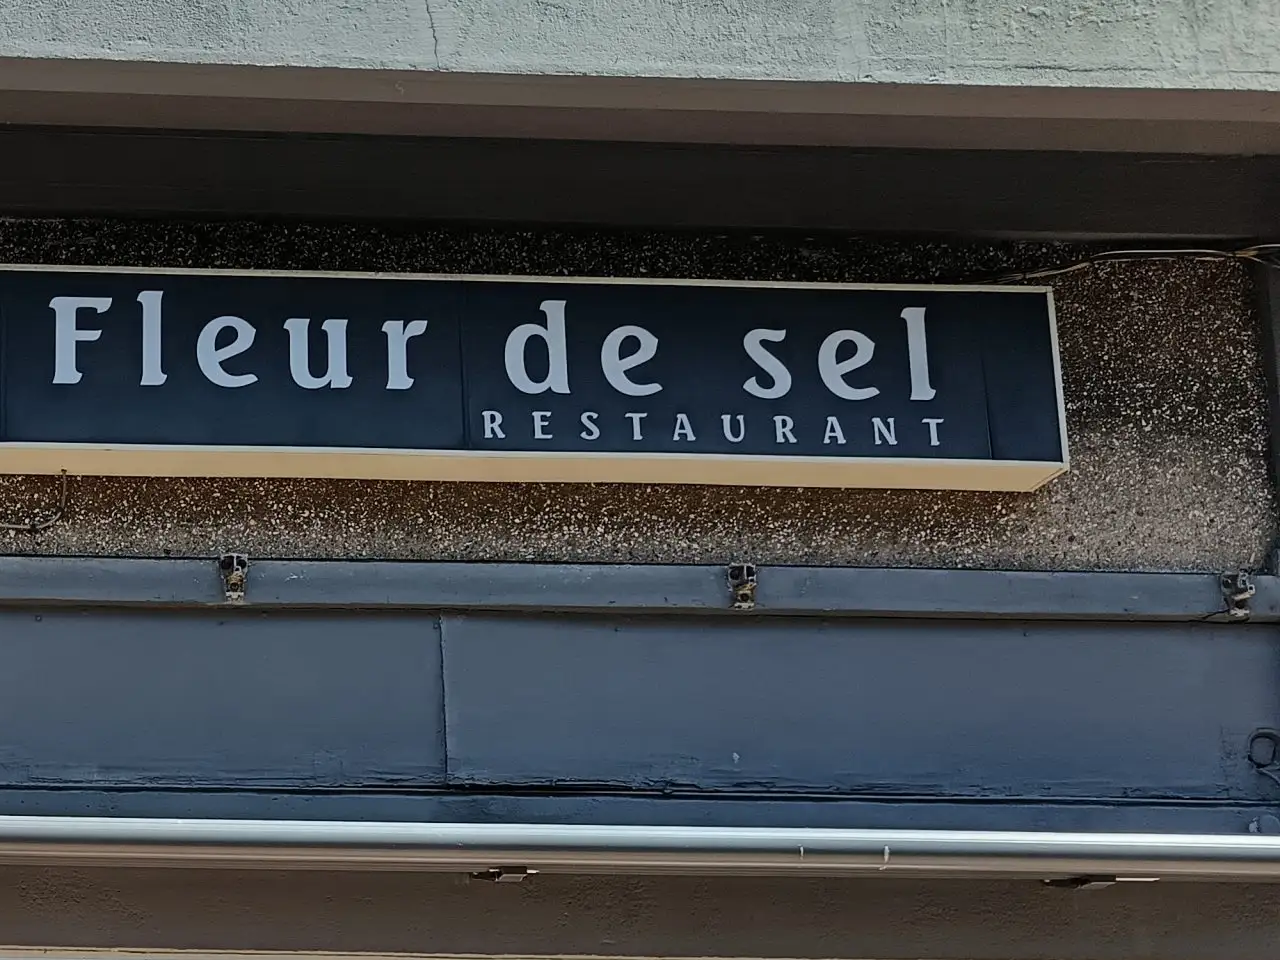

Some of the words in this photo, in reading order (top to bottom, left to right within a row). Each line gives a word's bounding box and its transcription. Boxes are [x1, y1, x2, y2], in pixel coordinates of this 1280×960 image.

[48, 290, 428, 392] Fleur
[503, 299, 663, 397] de
[742, 306, 937, 401] sel
[482, 411, 944, 448] RESTAURANT
